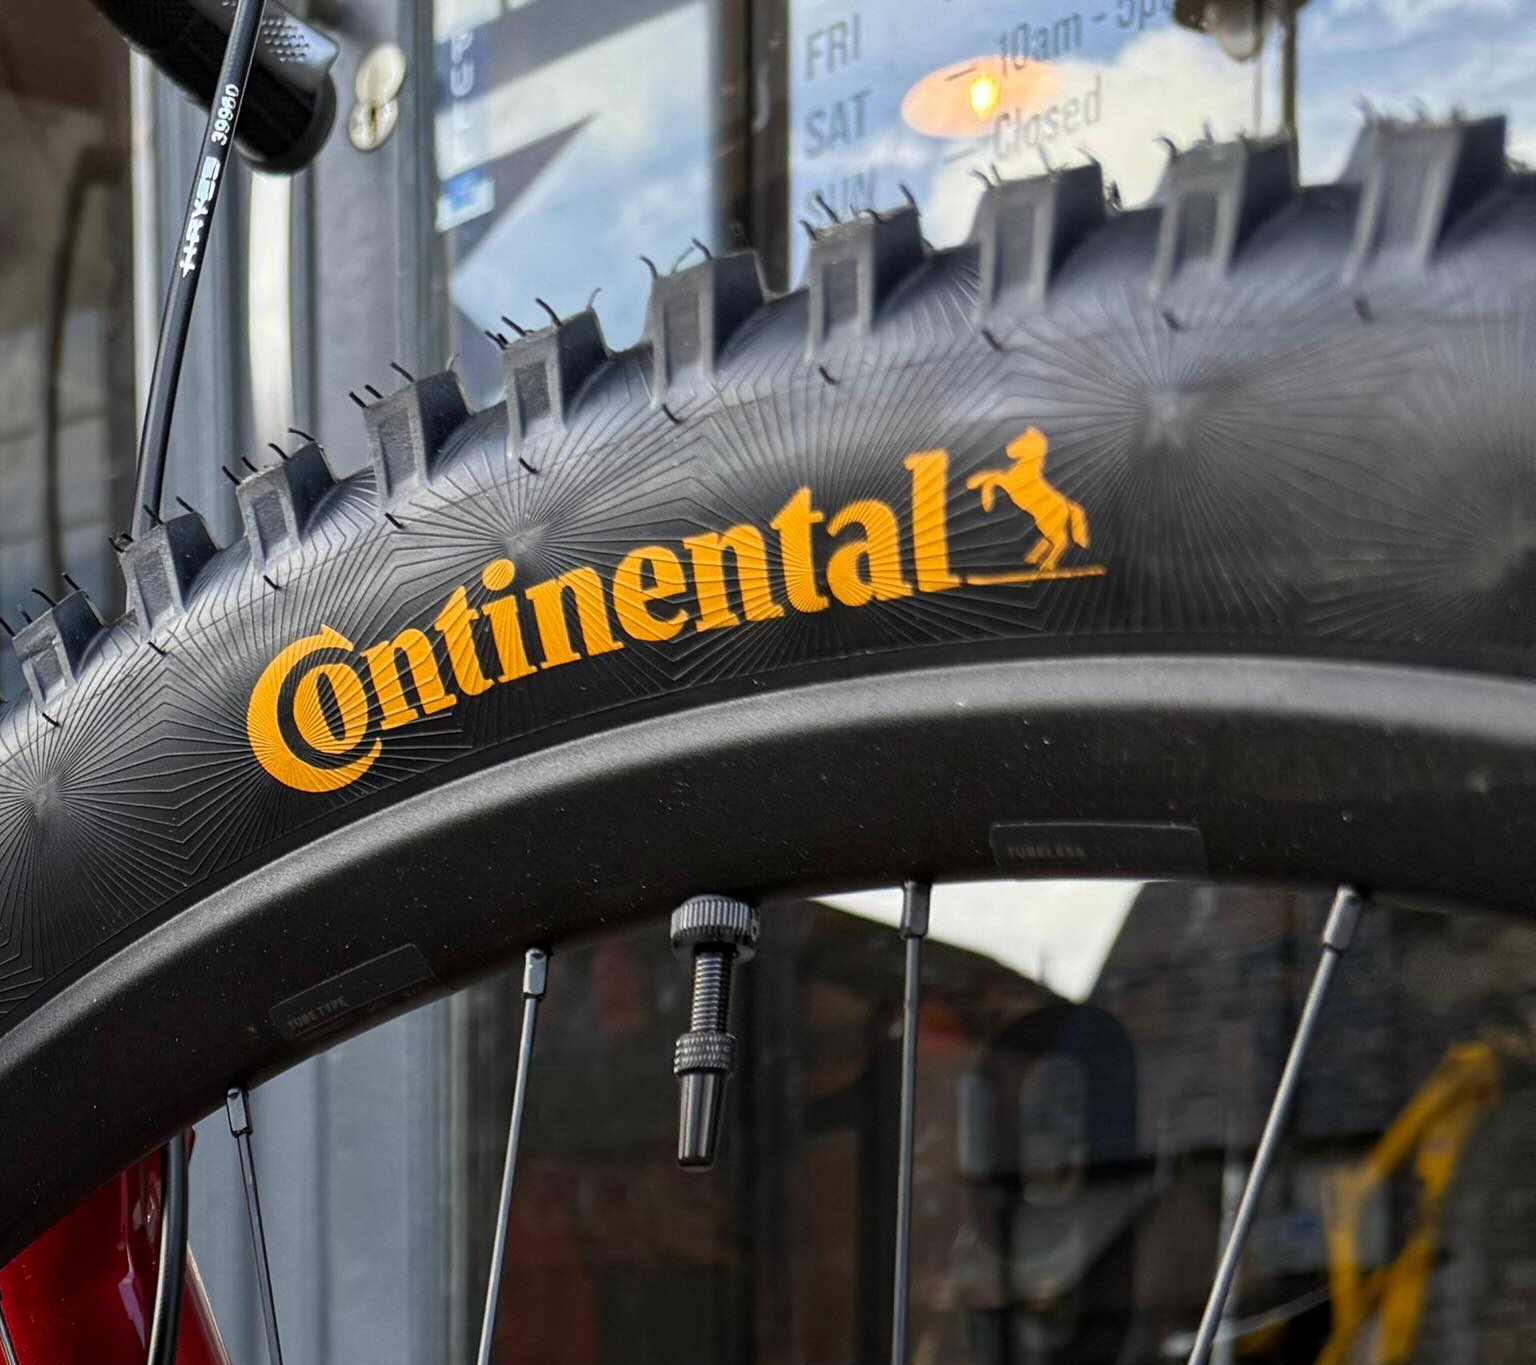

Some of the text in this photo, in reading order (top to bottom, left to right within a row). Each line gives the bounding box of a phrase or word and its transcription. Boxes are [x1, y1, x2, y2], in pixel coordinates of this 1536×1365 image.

[803, 87, 873, 159] SAT
[997, 13, 1083, 77] 10am
[805, 13, 862, 81] FRI
[992, 75, 1103, 160] Closed
[246, 448, 963, 793] Continental
